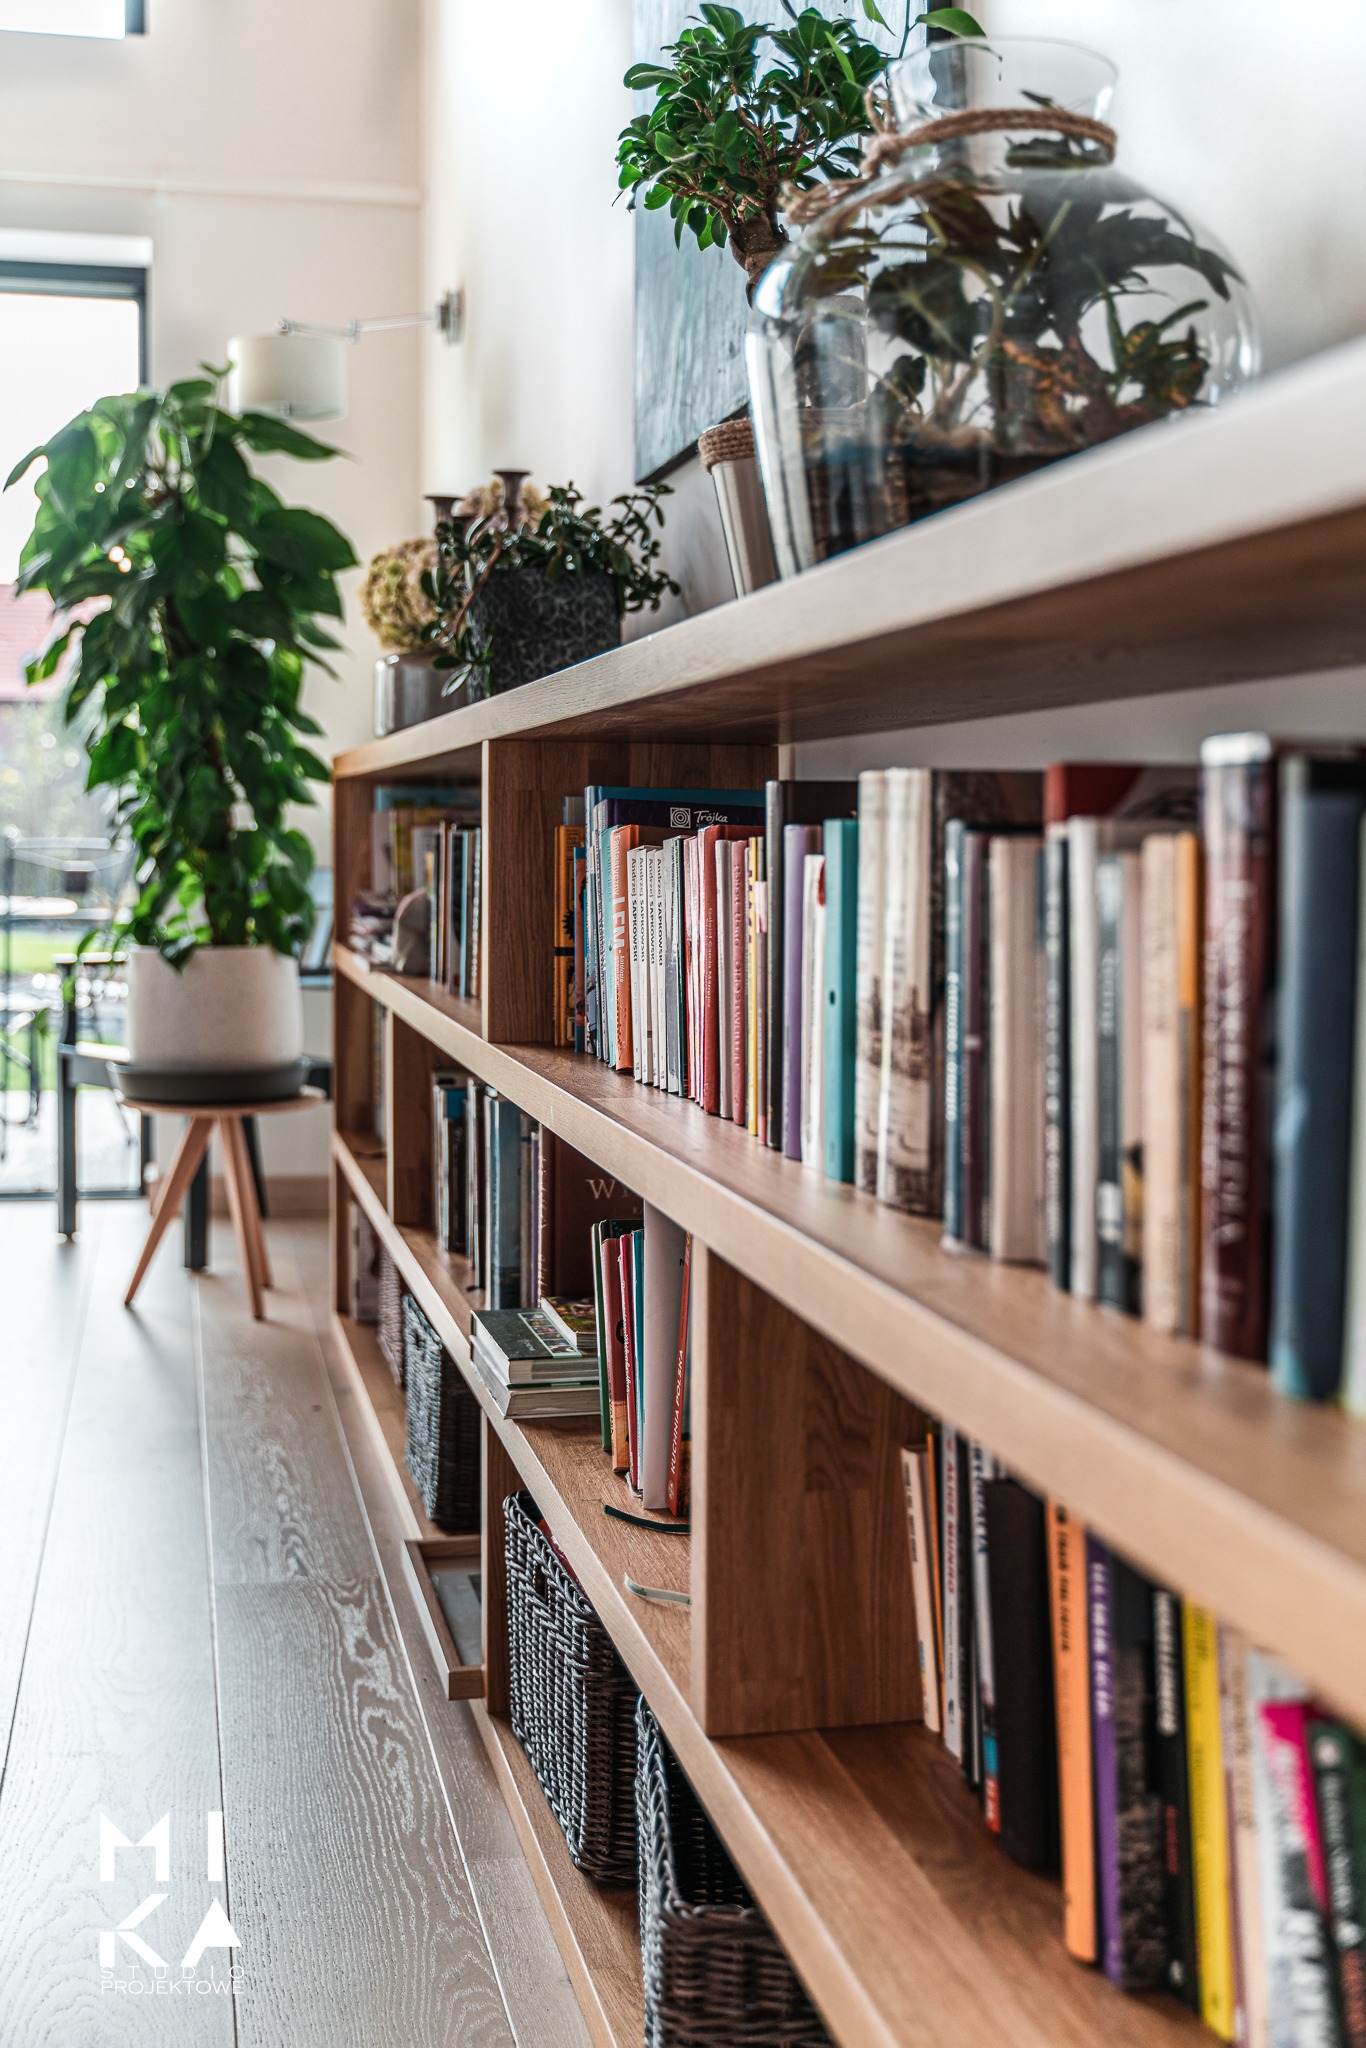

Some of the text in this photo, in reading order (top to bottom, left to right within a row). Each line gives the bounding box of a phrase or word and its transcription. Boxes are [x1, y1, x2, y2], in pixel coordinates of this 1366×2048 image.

[693, 810, 728, 824] Trójka
[613, 897, 625, 950] LEM
[670, 1409, 680, 1475] KUCHNIA
[675, 1348, 684, 1407] POLSKA
[946, 1463, 955, 1517] ALICE
[947, 1521, 956, 1594] MUNRO
